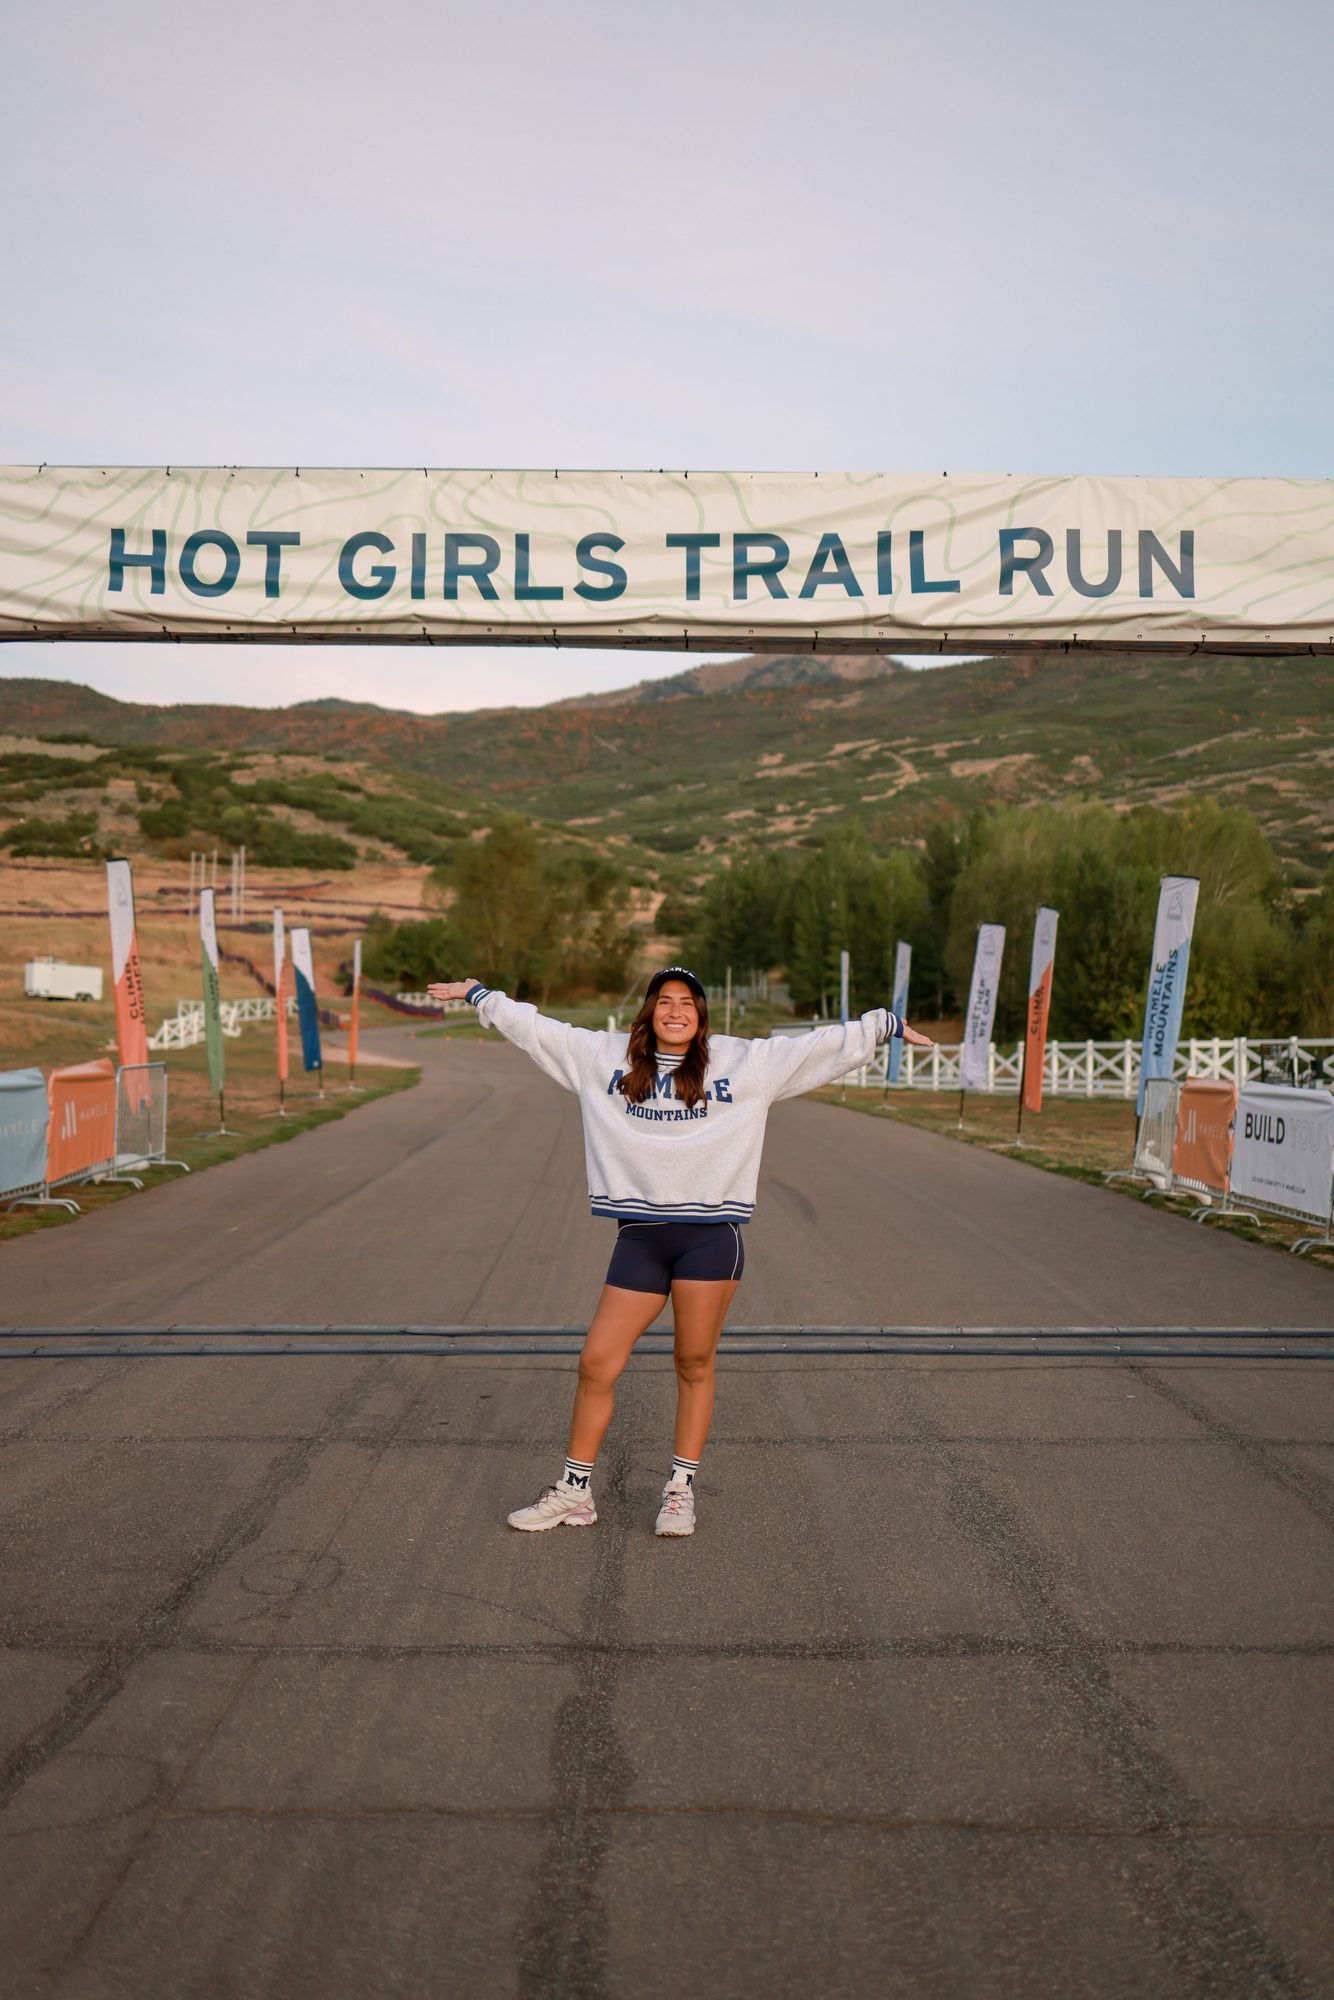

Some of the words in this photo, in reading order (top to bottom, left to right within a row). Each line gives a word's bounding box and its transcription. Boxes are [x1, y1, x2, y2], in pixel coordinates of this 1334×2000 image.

[108, 528, 300, 599] HOT
[338, 531, 627, 601] GIRLS
[666, 530, 960, 600] TRAIL
[999, 527, 1195, 598] RUN
[978, 1020, 988, 1038] WE
[983, 989, 991, 1015] CAN
[1153, 949, 1178, 1057] MOUNTAINS
[626, 1102, 708, 1121] MOUNTAINS
[1245, 1113, 1286, 1145] BUILD
[565, 1470, 590, 1490] M
